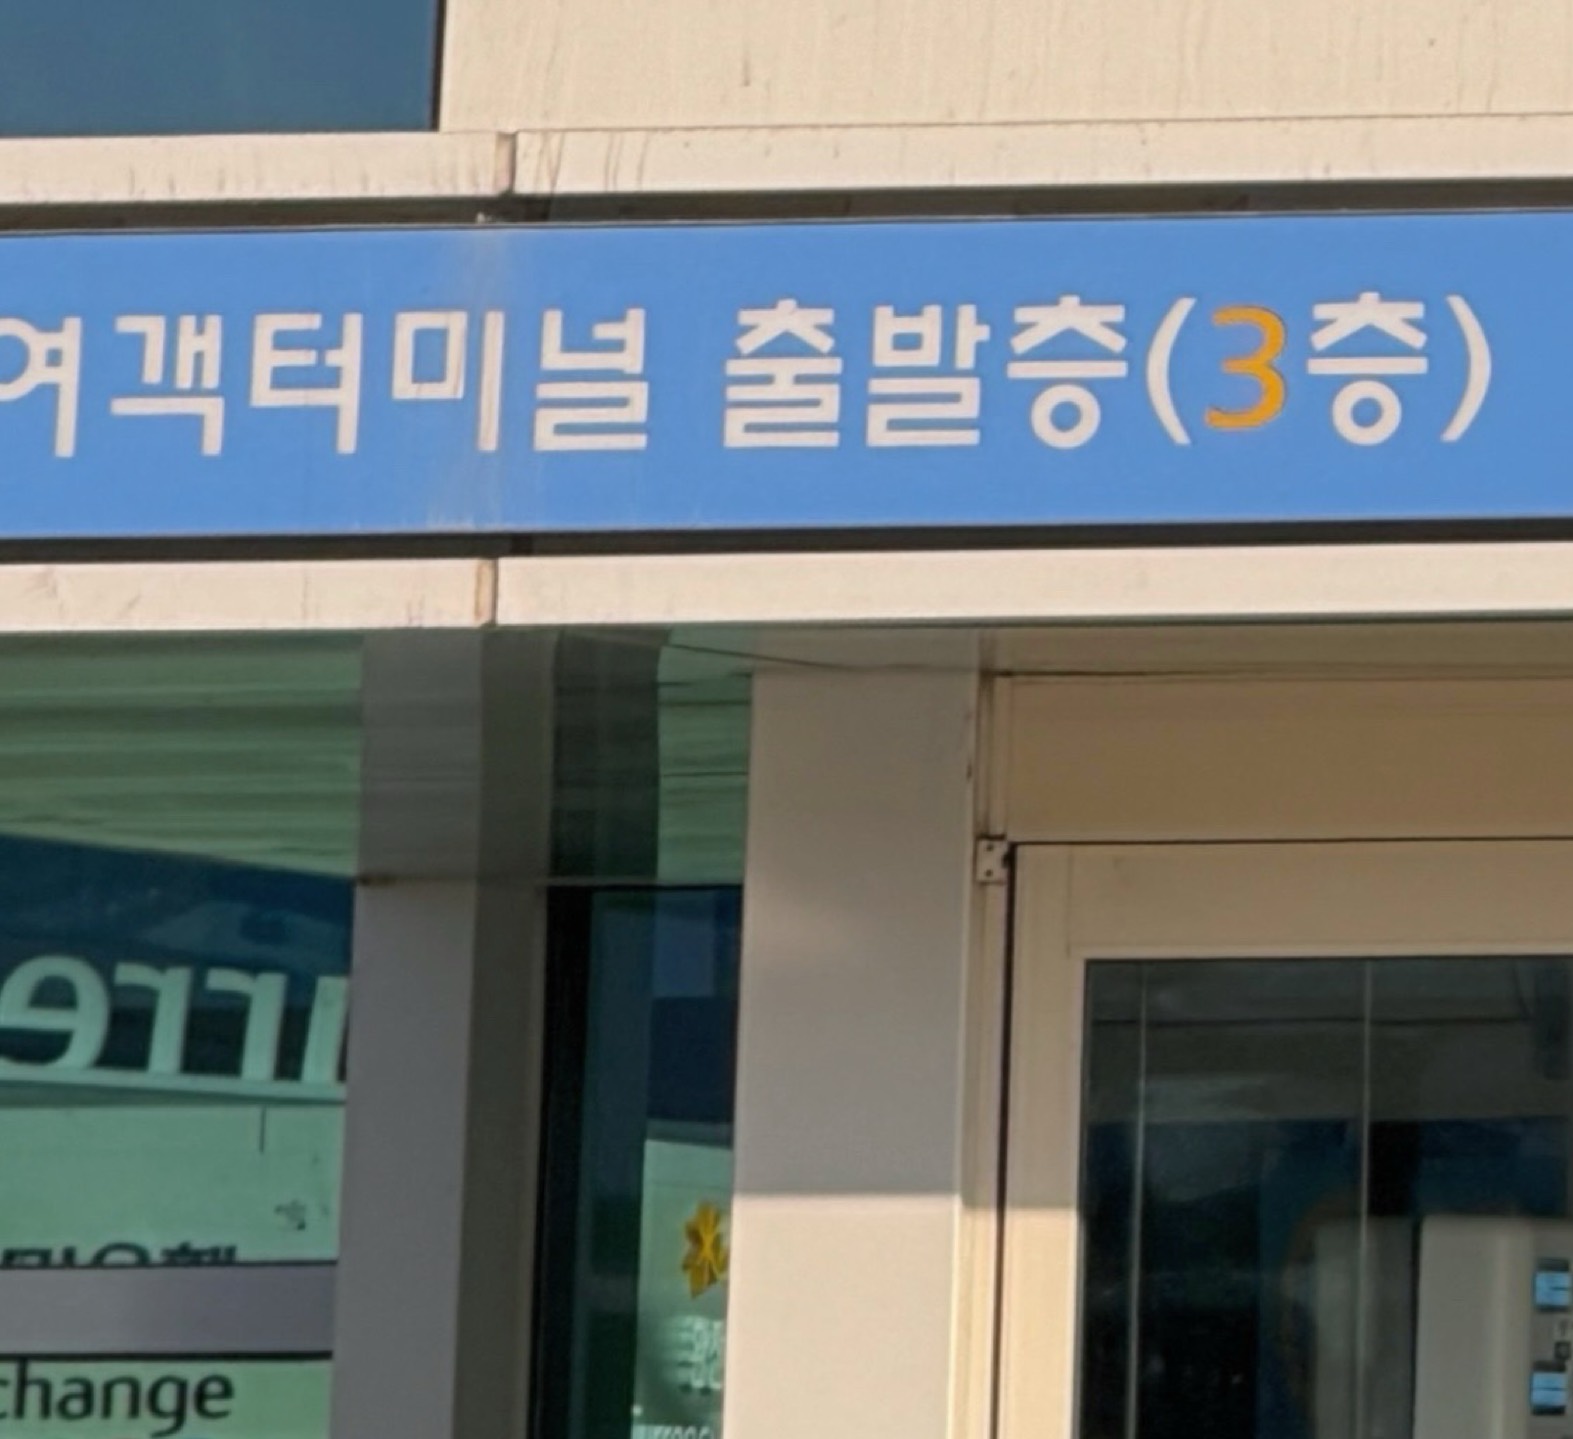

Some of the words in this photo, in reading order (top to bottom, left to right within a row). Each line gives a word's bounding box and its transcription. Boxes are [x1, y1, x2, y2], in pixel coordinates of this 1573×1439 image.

[0, 306, 650, 457] 여객터미널
[722, 292, 1494, 451] 출발층(3층)
[0, 1358, 236, 1439] hange
